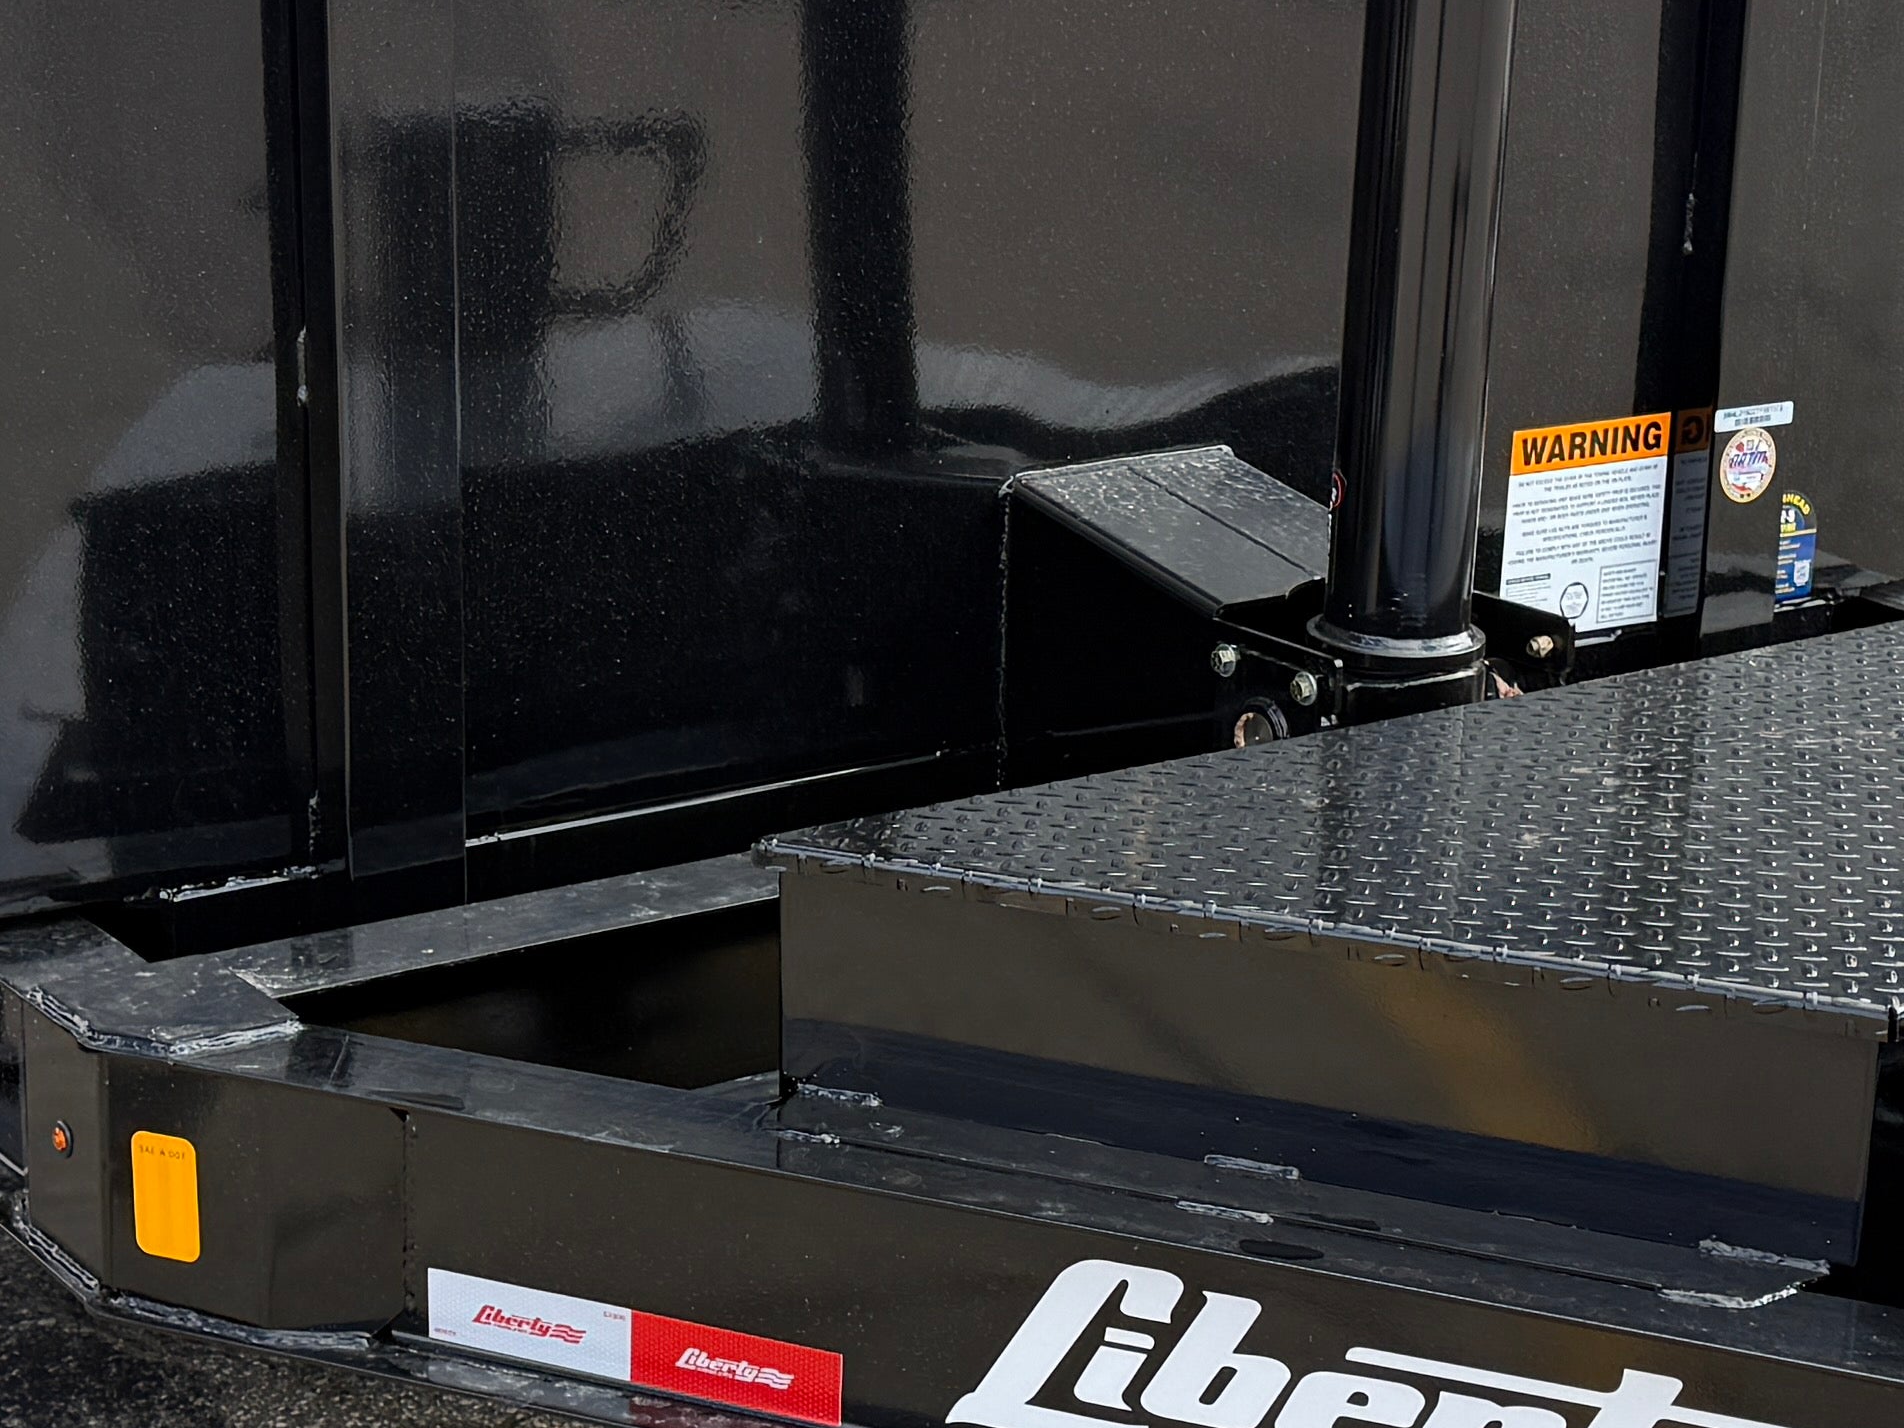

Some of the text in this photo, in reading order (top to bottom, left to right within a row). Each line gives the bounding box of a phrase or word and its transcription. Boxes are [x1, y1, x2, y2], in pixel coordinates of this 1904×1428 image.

[1522, 421, 1662, 466] WARNING
[472, 1304, 554, 1338] Liberty
[675, 1347, 763, 1383] Liberty
